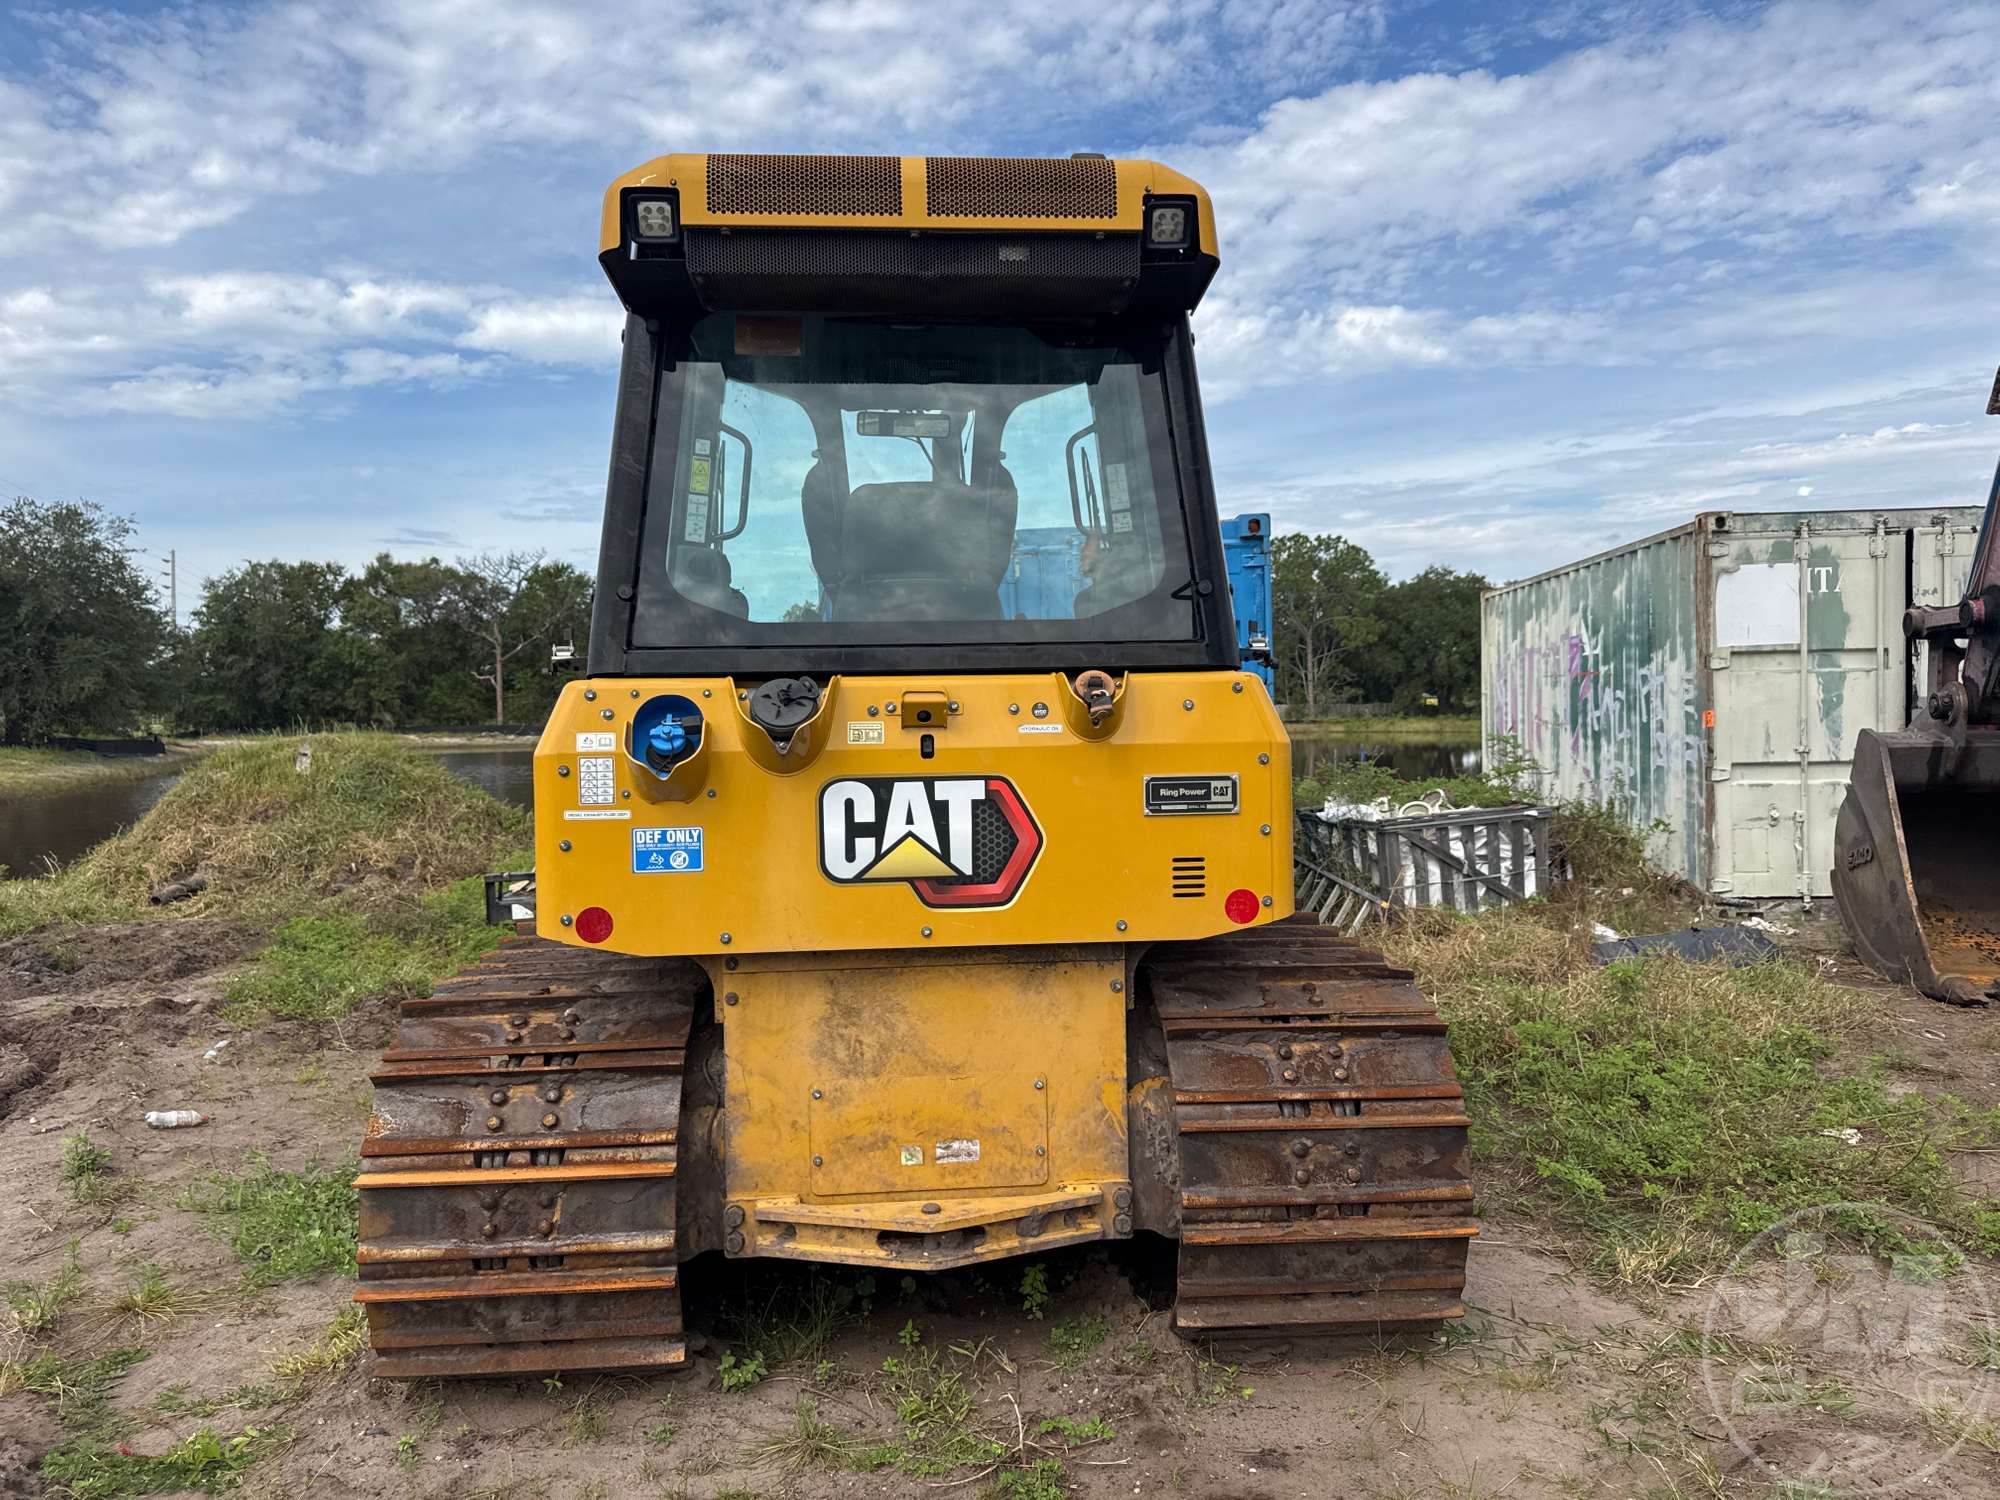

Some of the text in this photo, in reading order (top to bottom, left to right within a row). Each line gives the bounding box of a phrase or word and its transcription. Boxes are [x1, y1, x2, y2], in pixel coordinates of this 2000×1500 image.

[1159, 788, 1207, 797] Ring Power
[1213, 786, 1230, 797] CAT
[822, 779, 986, 880] CAT
[636, 829, 700, 844] DEF ONLY
